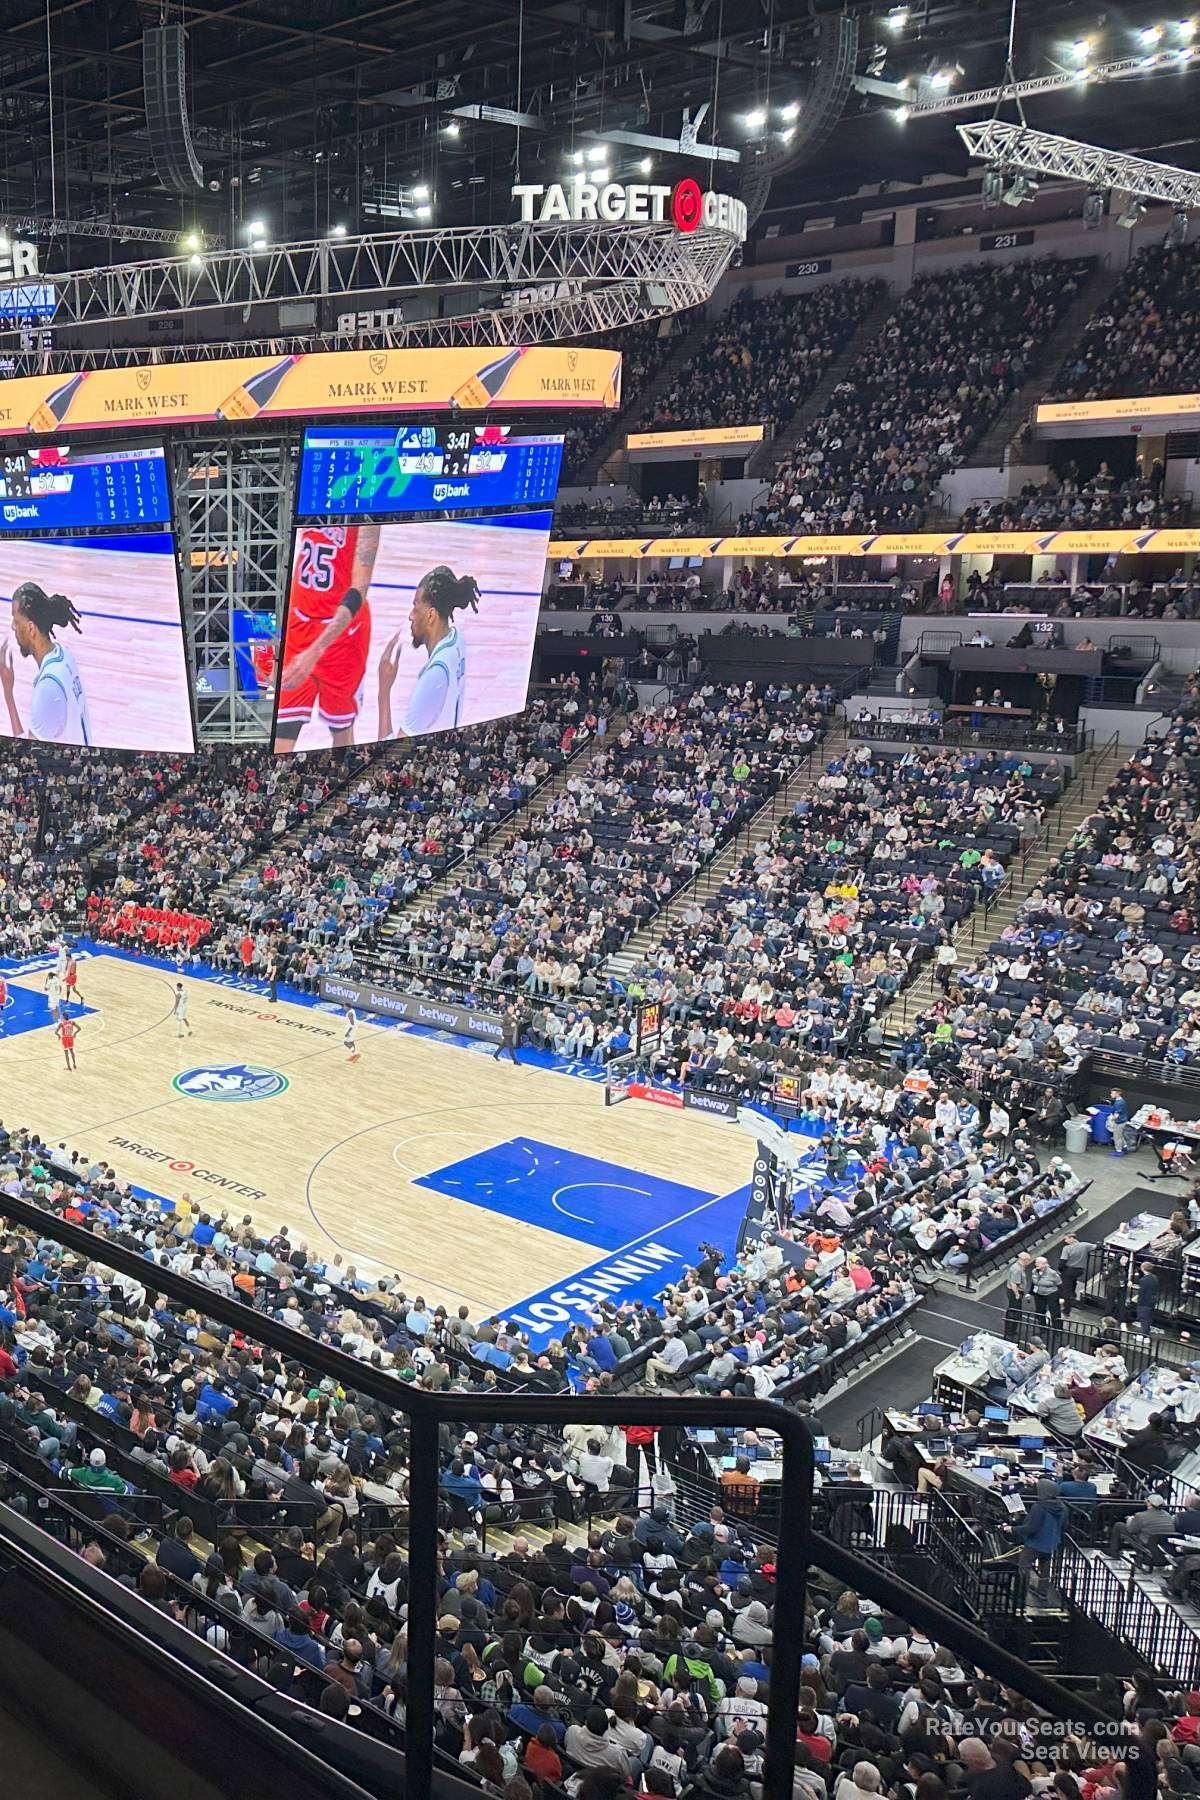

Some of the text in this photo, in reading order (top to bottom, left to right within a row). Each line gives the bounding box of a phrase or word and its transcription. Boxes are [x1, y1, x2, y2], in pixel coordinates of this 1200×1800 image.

[511, 183, 672, 223] TARGET
[994, 235, 1018, 248] 231
[798, 263, 819, 275] 230
[328, 379, 428, 398] MARK WEST
[540, 378, 596, 391] MARK WEST
[104, 393, 189, 412] MARK WEST
[447, 432, 470, 450] 3:41
[330, 451, 336, 460] 4
[416, 452, 434, 472] 43
[476, 451, 492, 470] 52
[4, 455, 26, 473] 3:41
[105, 465, 112, 474] 0
[329, 464, 335, 473] 5
[443, 463, 468, 474] 6 2 4
[39, 472, 55, 492] 52
[106, 477, 114, 485] 12
[328, 476, 334, 485] 7
[16, 487, 22, 496] 2
[25, 486, 31, 495] 4
[107, 488, 115, 497] 15
[326, 488, 332, 497] 3
[447, 483, 470, 497] bank
[137, 497, 143, 506] 3
[325, 500, 331, 509] 4
[16, 504, 39, 518] bank
[138, 509, 144, 518] 4
[299, 539, 338, 592] 25
[600, 614, 614, 623] 130
[1034, 623, 1054, 632] 132
[325, 982, 361, 1002] betway
[370, 993, 408, 1014] betway
[207, 999, 336, 1038] TARGET CENTER
[419, 1005, 459, 1026] betway
[468, 1017, 504, 1037] betwa
[690, 1093, 730, 1114] betway
[108, 1136, 267, 1200] TARGET CENTER
[509, 1242, 685, 1334] MINNESOT
